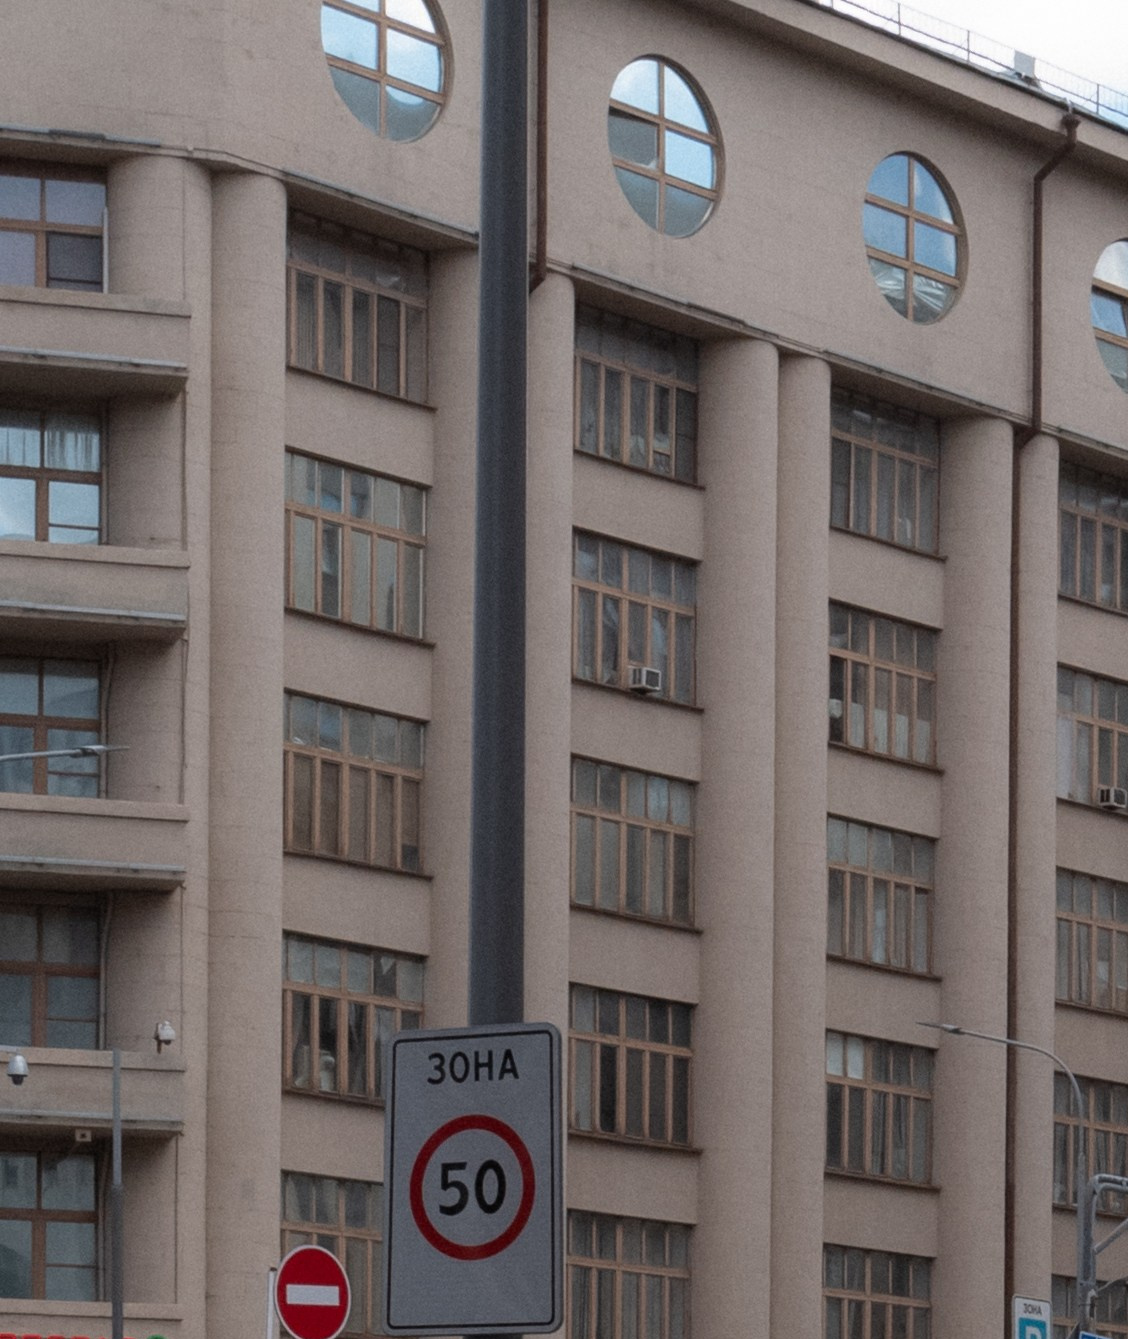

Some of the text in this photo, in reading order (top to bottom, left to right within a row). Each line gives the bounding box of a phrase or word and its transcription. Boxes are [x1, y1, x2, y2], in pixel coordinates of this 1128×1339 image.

[427, 1048, 520, 1085] ЗОНА
[438, 1159, 507, 1217] 50
[1023, 1302, 1043, 1316] ЗОНА
